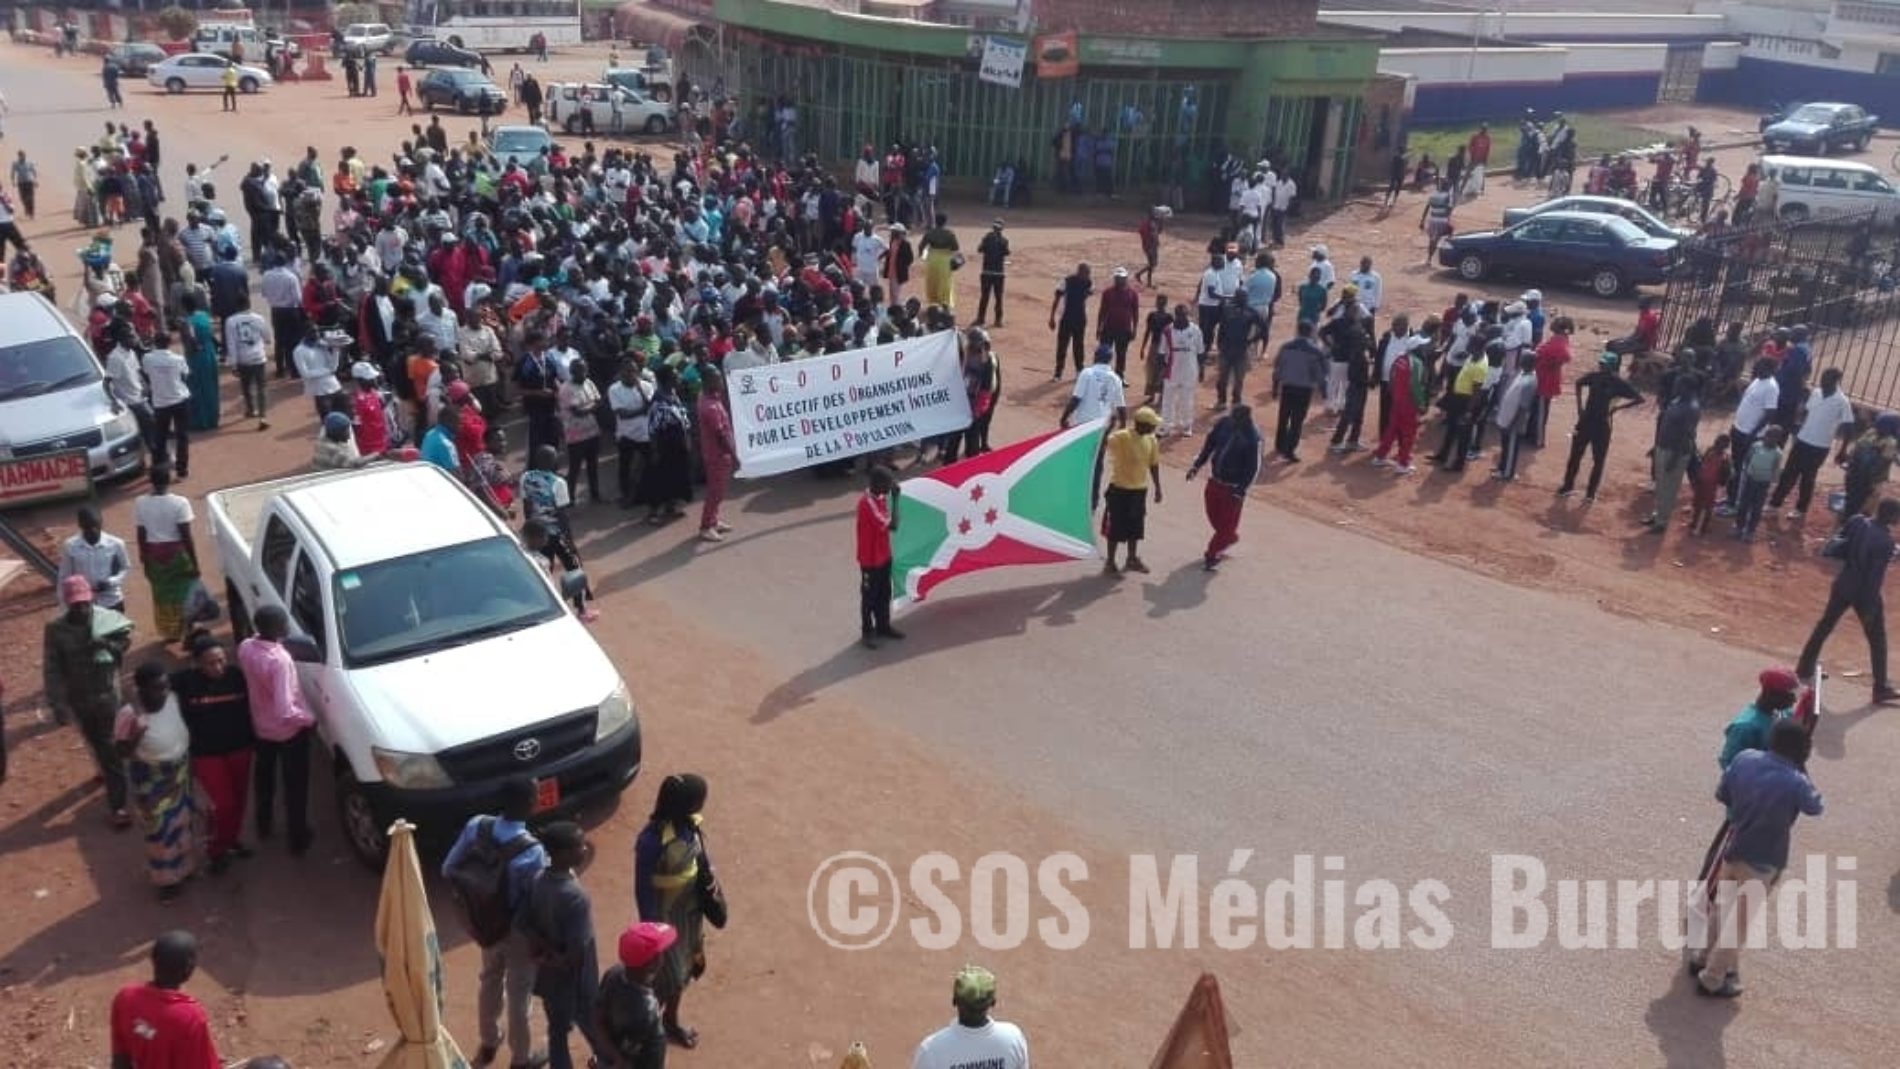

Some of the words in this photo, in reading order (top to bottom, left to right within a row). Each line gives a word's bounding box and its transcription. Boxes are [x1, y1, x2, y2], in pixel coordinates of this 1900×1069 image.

[755, 397, 819, 422] COLLECTIF
[823, 393, 845, 410] DES
[849, 371, 933, 402] ORGANISATIONS
[748, 429, 779, 448] POUR
[781, 424, 798, 440] LE
[801, 400, 905, 435] DEVELOPPEMENT
[805, 443, 821, 458] DE
[825, 439, 842, 453] LA
[843, 421, 915, 448] POPULATION
